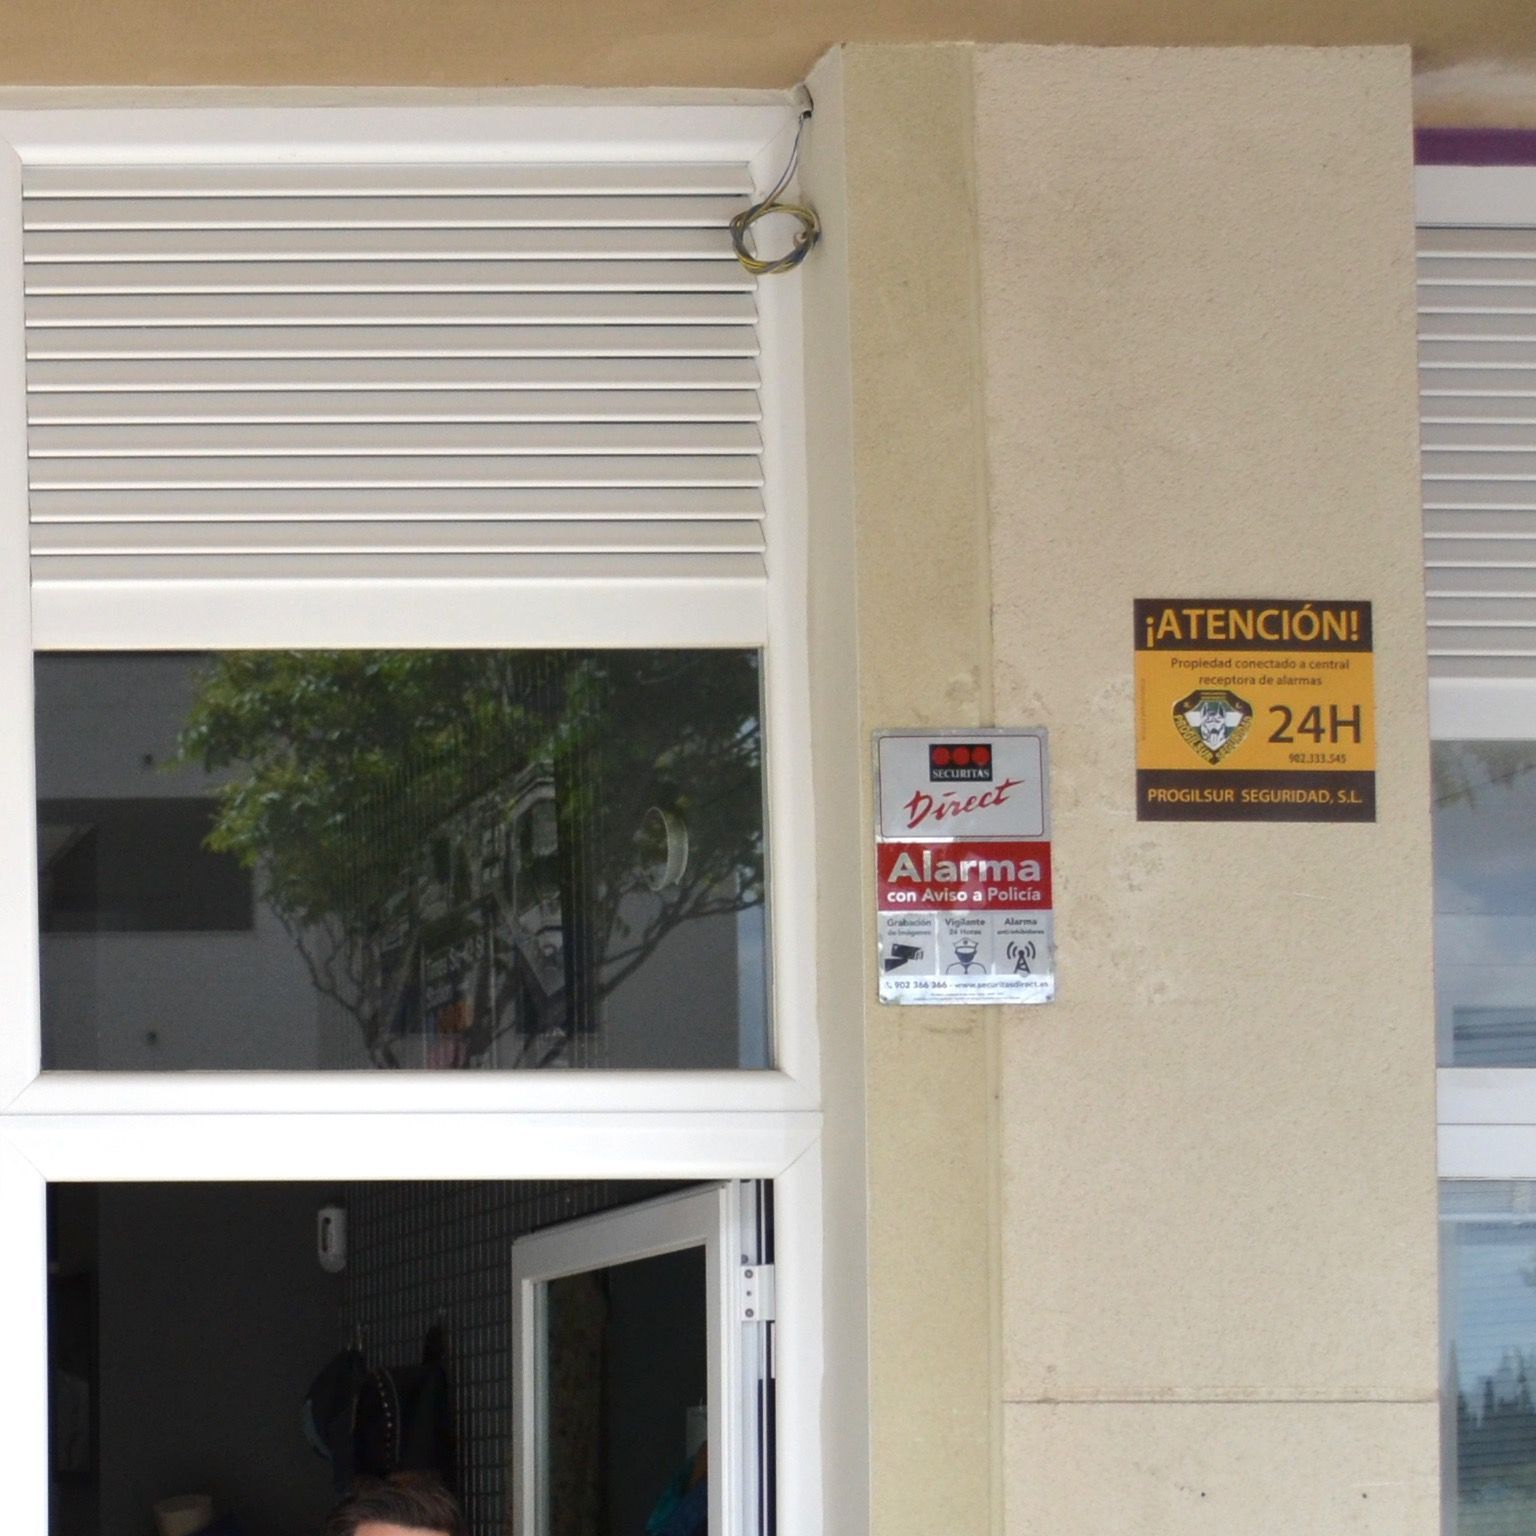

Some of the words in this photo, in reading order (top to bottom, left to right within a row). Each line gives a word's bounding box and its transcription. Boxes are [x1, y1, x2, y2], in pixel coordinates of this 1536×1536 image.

[1145, 604, 1360, 648] ¡ATENCIÓN!
[1171, 658, 1232, 671] Propiedad
[1235, 658, 1296, 670] conectado
[1299, 661, 1306, 670] a
[1309, 659, 1350, 670] central
[1199, 676, 1256, 687] receptora
[1260, 676, 1274, 686] de
[1277, 676, 1322, 686] alarmas
[1268, 704, 1361, 743] 24H
[932, 769, 990, 779] SECURITAS
[904, 778, 1025, 829] Direct
[1148, 788, 1234, 802] PROGILSUR
[1241, 789, 1332, 805] SEGURIDAD,
[1337, 791, 1363, 804] S.L.
[887, 850, 1041, 883] Alarma
[887, 890, 916, 902] con
[922, 887, 968, 902] Aviso
[972, 891, 983, 902] a
[988, 887, 1041, 902] Policía
[887, 918, 931, 926] Grabación
[945, 918, 985, 928] Vigilante
[1004, 918, 1037, 926] Alarma
